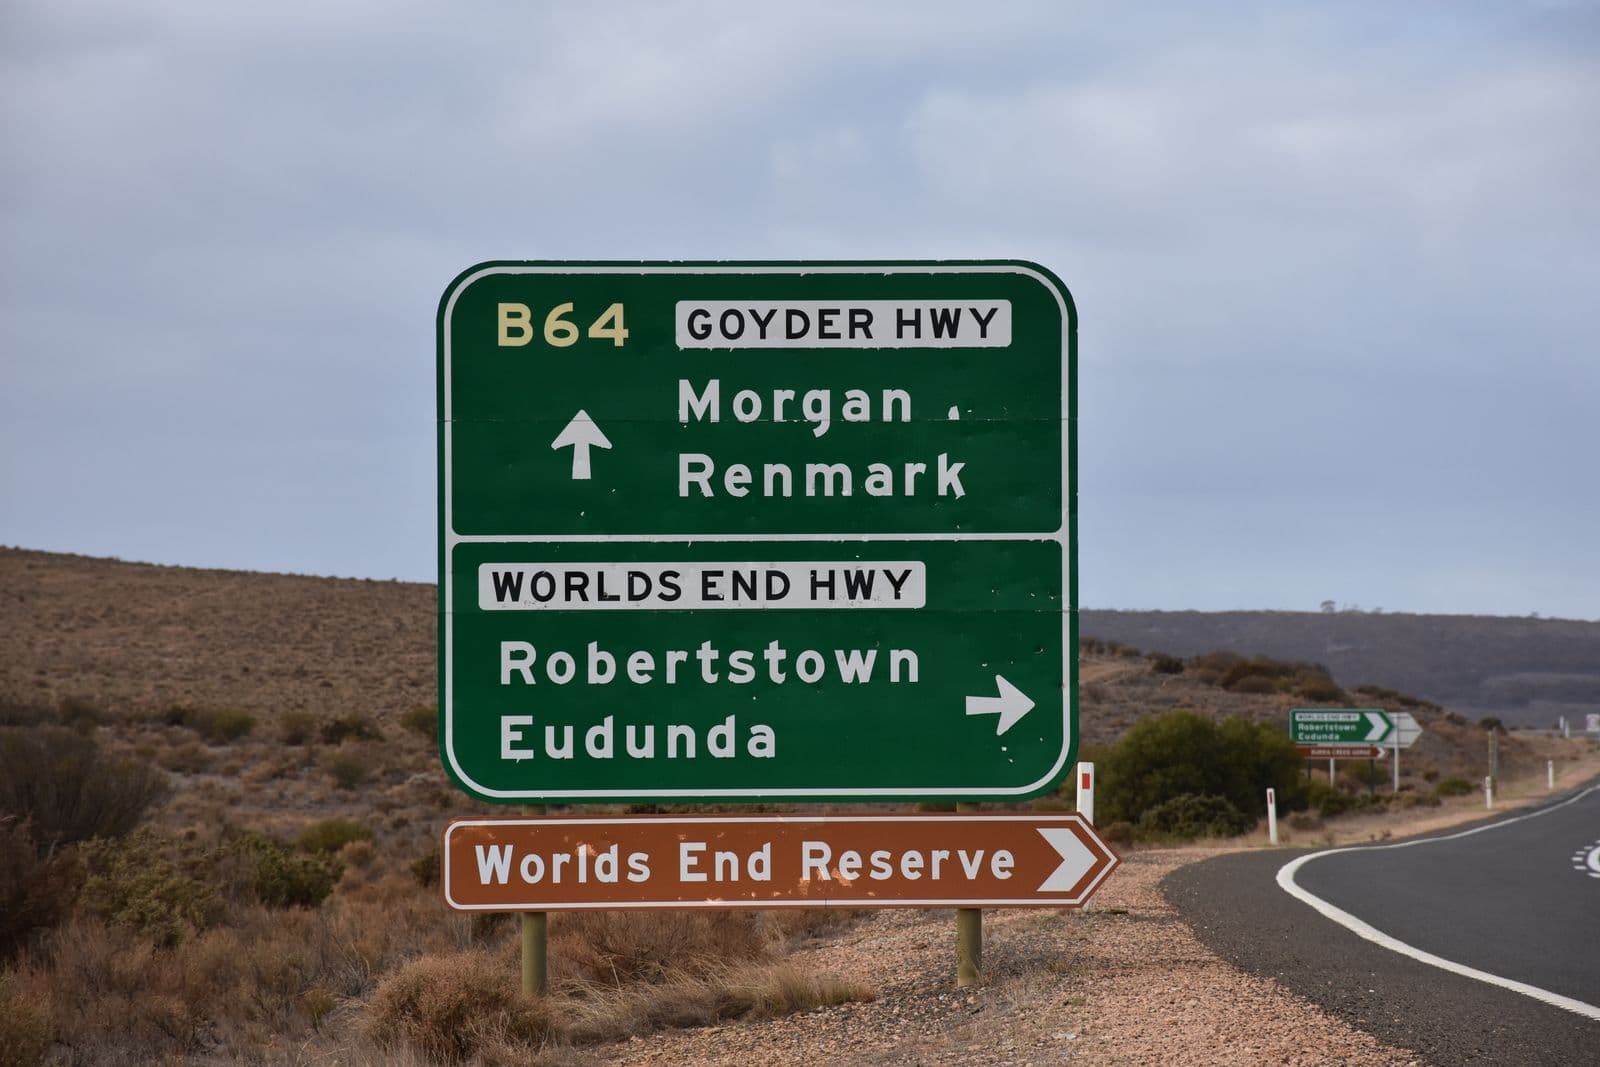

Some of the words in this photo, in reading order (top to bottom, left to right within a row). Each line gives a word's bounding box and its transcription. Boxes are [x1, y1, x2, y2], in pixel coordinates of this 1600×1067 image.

[498, 303, 628, 347] B64
[688, 308, 873, 339] GOYDER
[897, 308, 998, 338] HWY
[679, 379, 911, 437] Morgan
[679, 453, 965, 498] Renmark
[492, 571, 681, 601] WORLDS
[702, 571, 790, 600] END
[811, 570, 912, 600] HWY
[501, 640, 918, 684] Robertstown
[501, 715, 775, 759] Eudunda
[1298, 723, 1357, 731] Robertstown
[475, 844, 651, 884] Worlds
[680, 842, 771, 881] End
[800, 841, 1015, 882] Reserve
